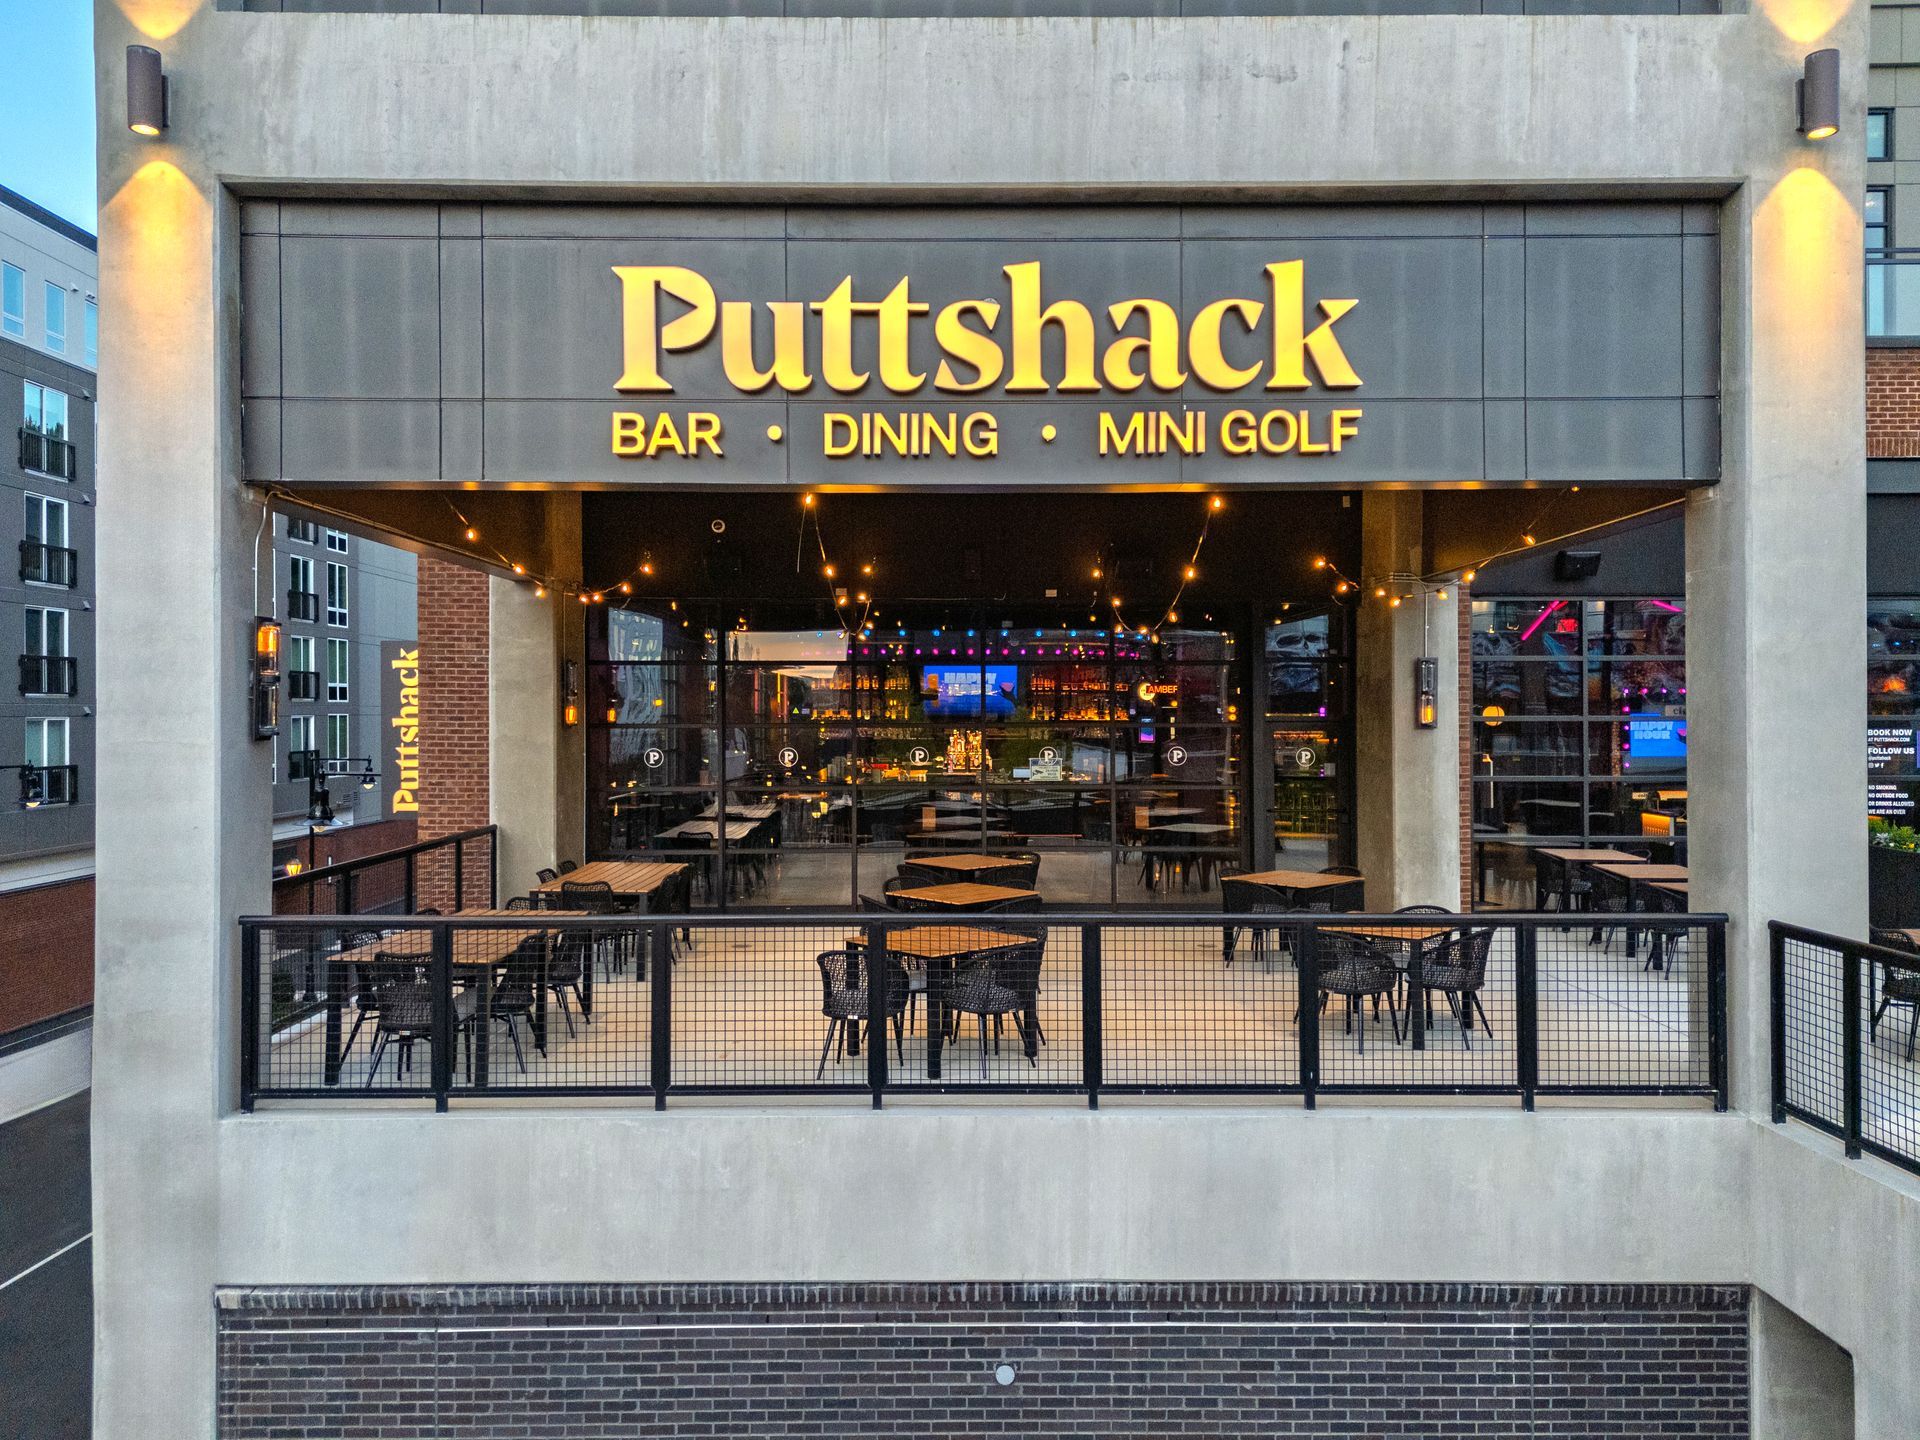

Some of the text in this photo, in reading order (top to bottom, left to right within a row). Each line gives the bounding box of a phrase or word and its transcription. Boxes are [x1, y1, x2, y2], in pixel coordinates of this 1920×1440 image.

[611, 259, 1364, 392] Puttshack
[612, 408, 1363, 456] BAR DINING MINI GOLF
[392, 648, 419, 813] Puttshack
[1630, 721, 1673, 731] HAPPY
[1634, 731, 1670, 740] HOUR
